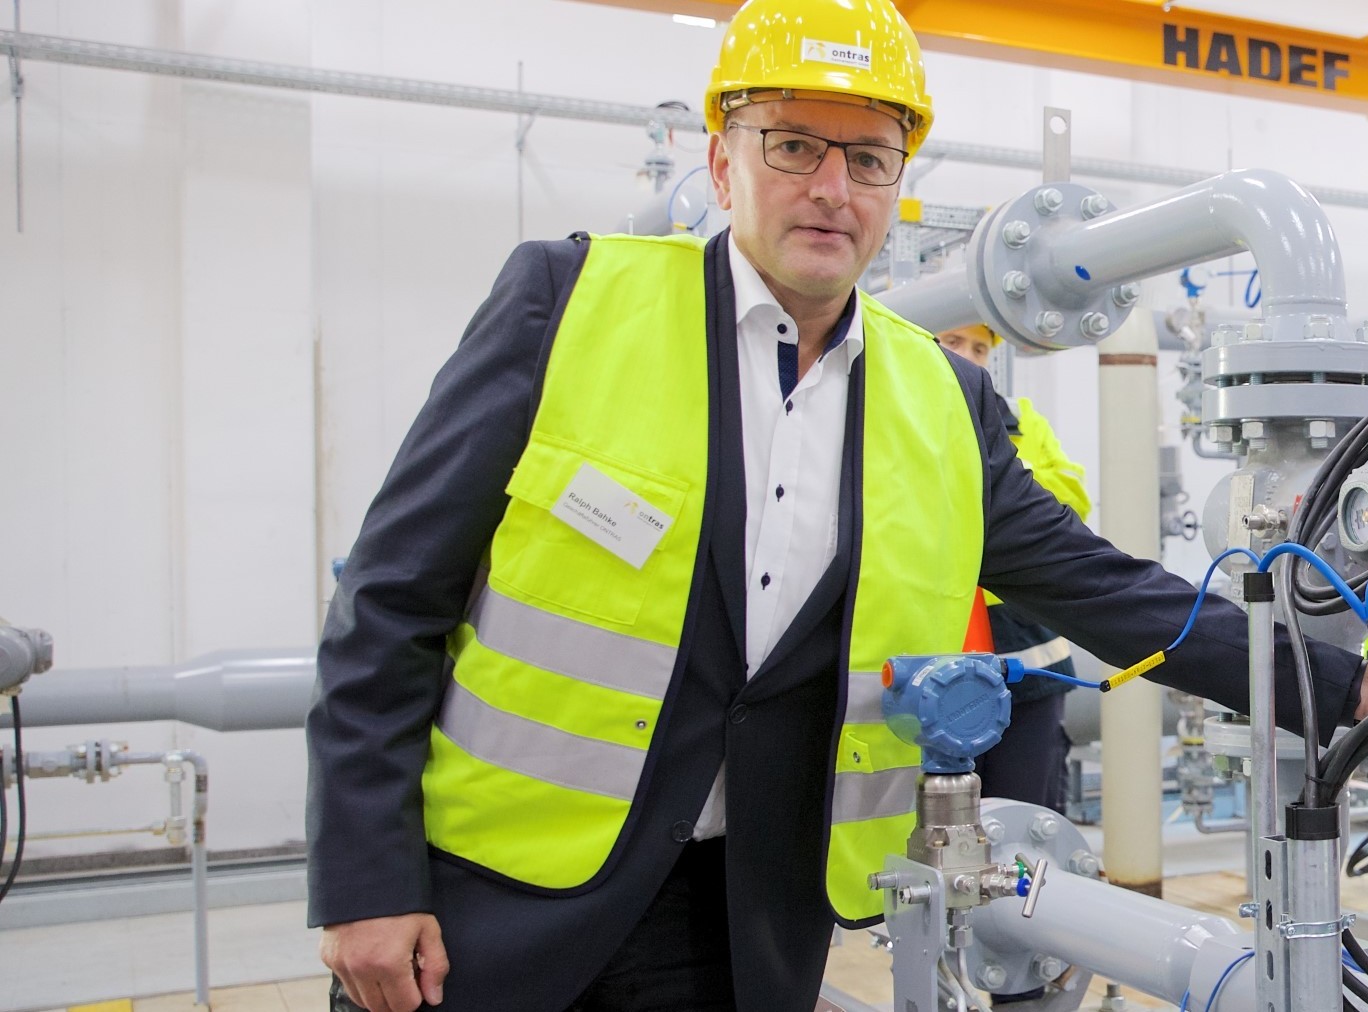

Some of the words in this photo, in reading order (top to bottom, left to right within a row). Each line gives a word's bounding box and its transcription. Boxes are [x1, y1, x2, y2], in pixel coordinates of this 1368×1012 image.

[832, 49, 870, 62] ontras
[1163, 23, 1350, 91] HADEF
[568, 492, 592, 511] Ralph
[592, 507, 617, 527] Bahke
[639, 511, 664, 530] ontras
